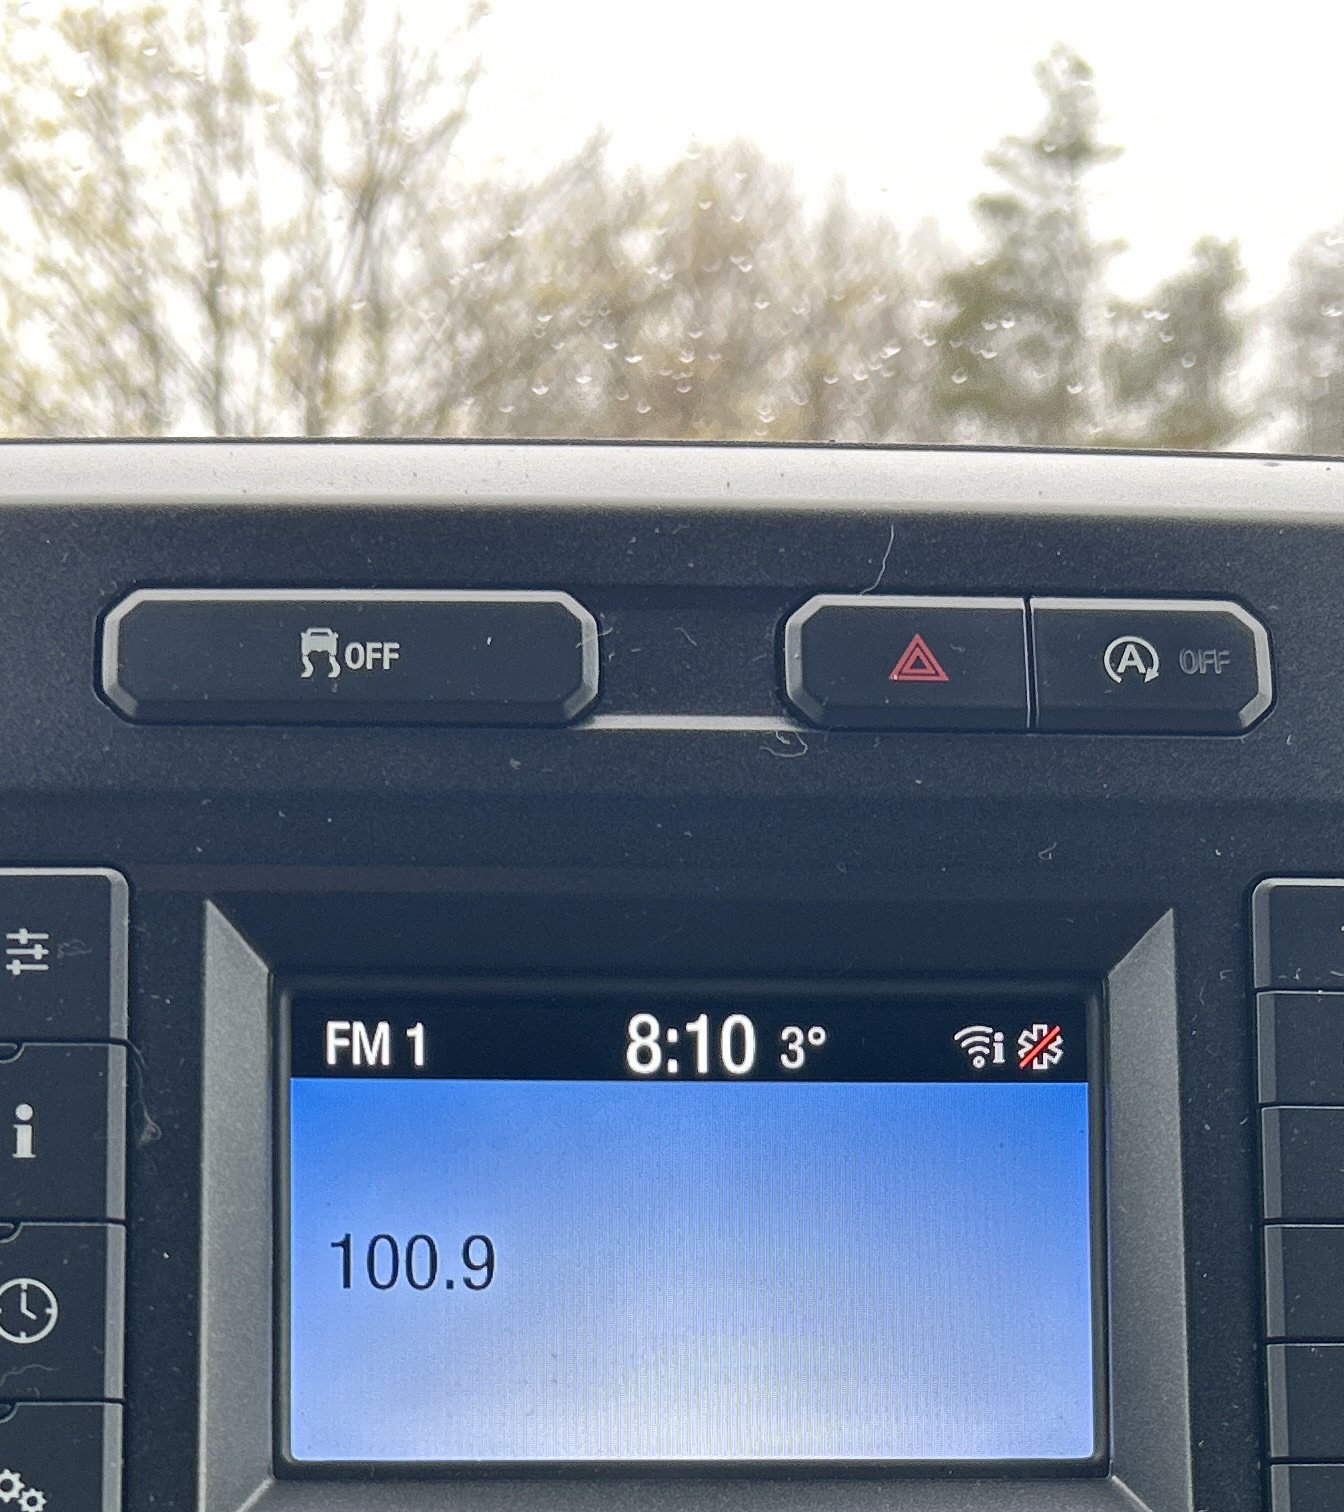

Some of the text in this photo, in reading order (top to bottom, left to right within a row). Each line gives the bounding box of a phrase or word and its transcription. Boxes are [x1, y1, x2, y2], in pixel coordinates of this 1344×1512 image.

[344, 641, 401, 670] OFF
[1178, 648, 1231, 675] OFF
[326, 1020, 425, 1067] FM 1
[626, 1013, 756, 1075] 8:10
[330, 1233, 496, 1291] 100.9
